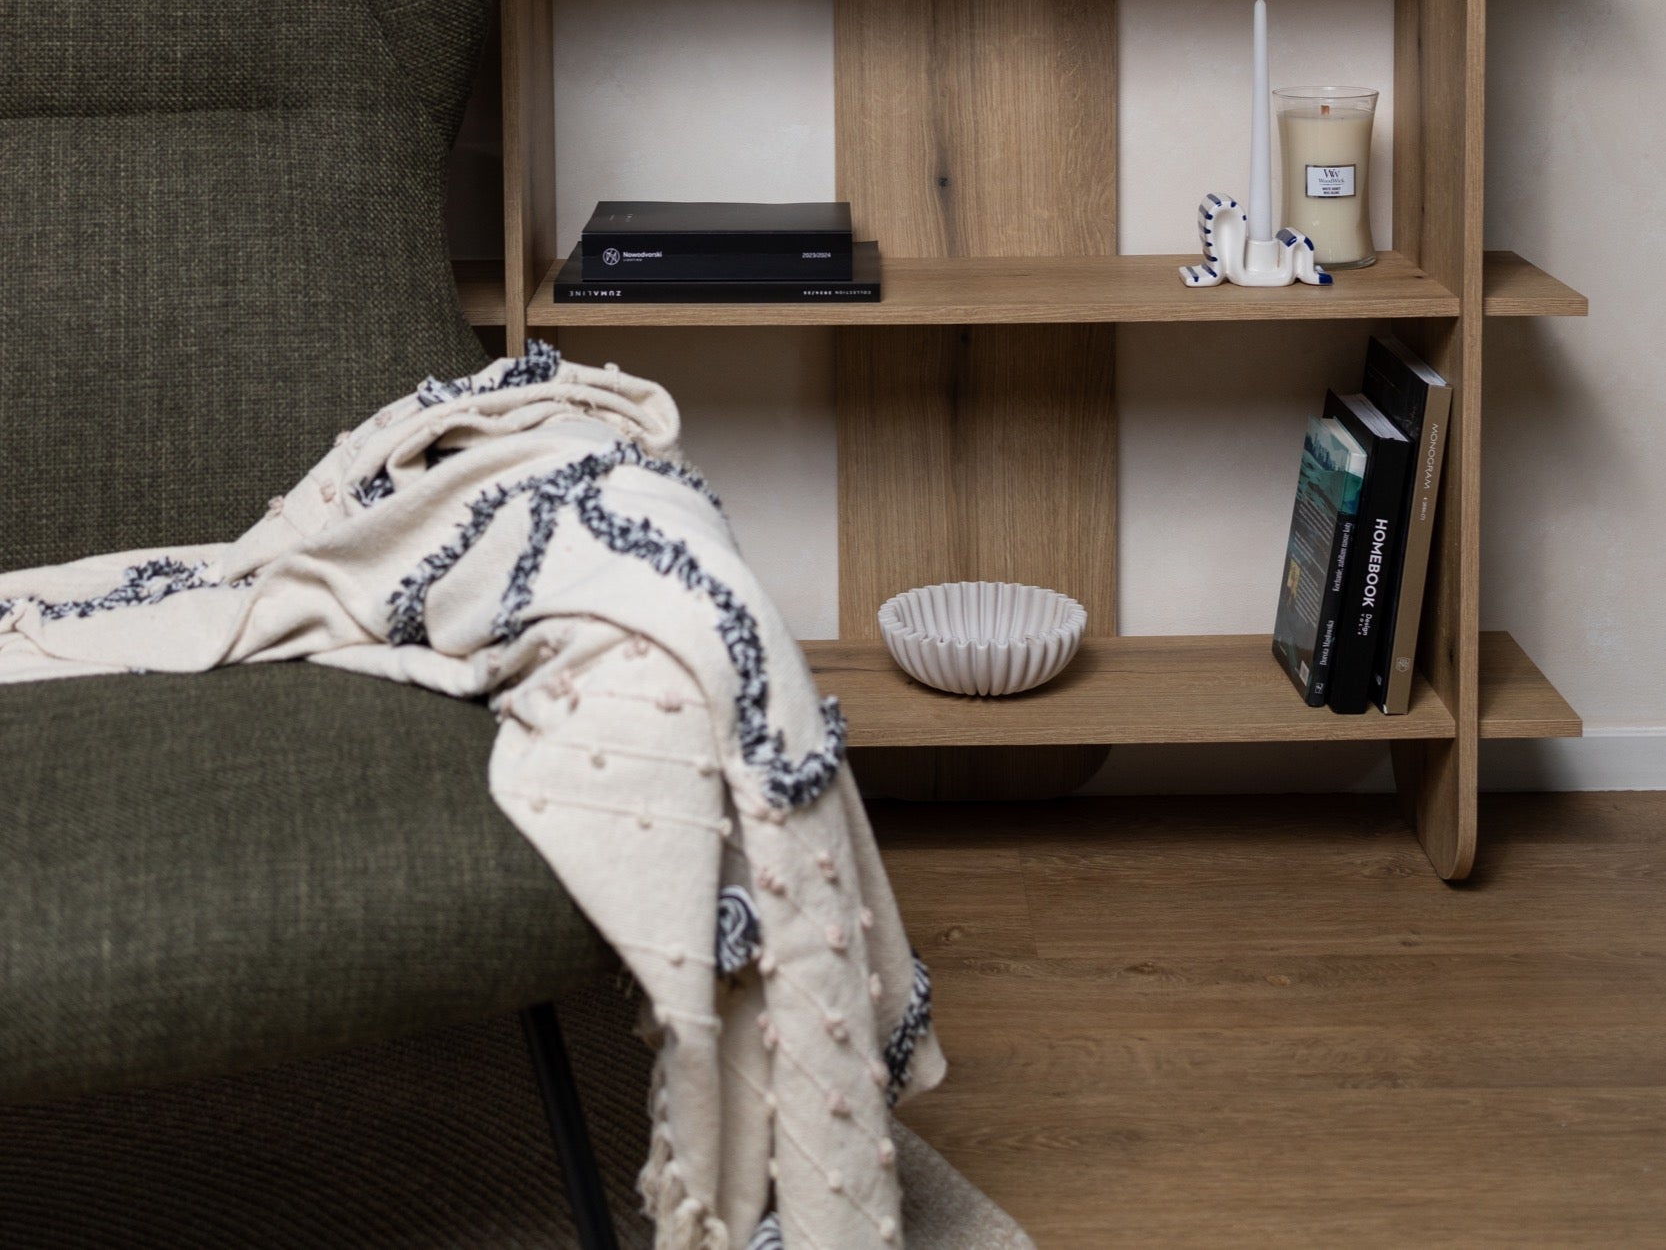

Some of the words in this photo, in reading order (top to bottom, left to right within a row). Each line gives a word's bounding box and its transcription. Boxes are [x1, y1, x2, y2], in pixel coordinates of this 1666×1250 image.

[622, 250, 662, 258] Nowodvorski
[1423, 423, 1439, 490] MONOGRAM
[1361, 518, 1389, 608] HOMEBOOK
[1362, 613, 1373, 636] Design
